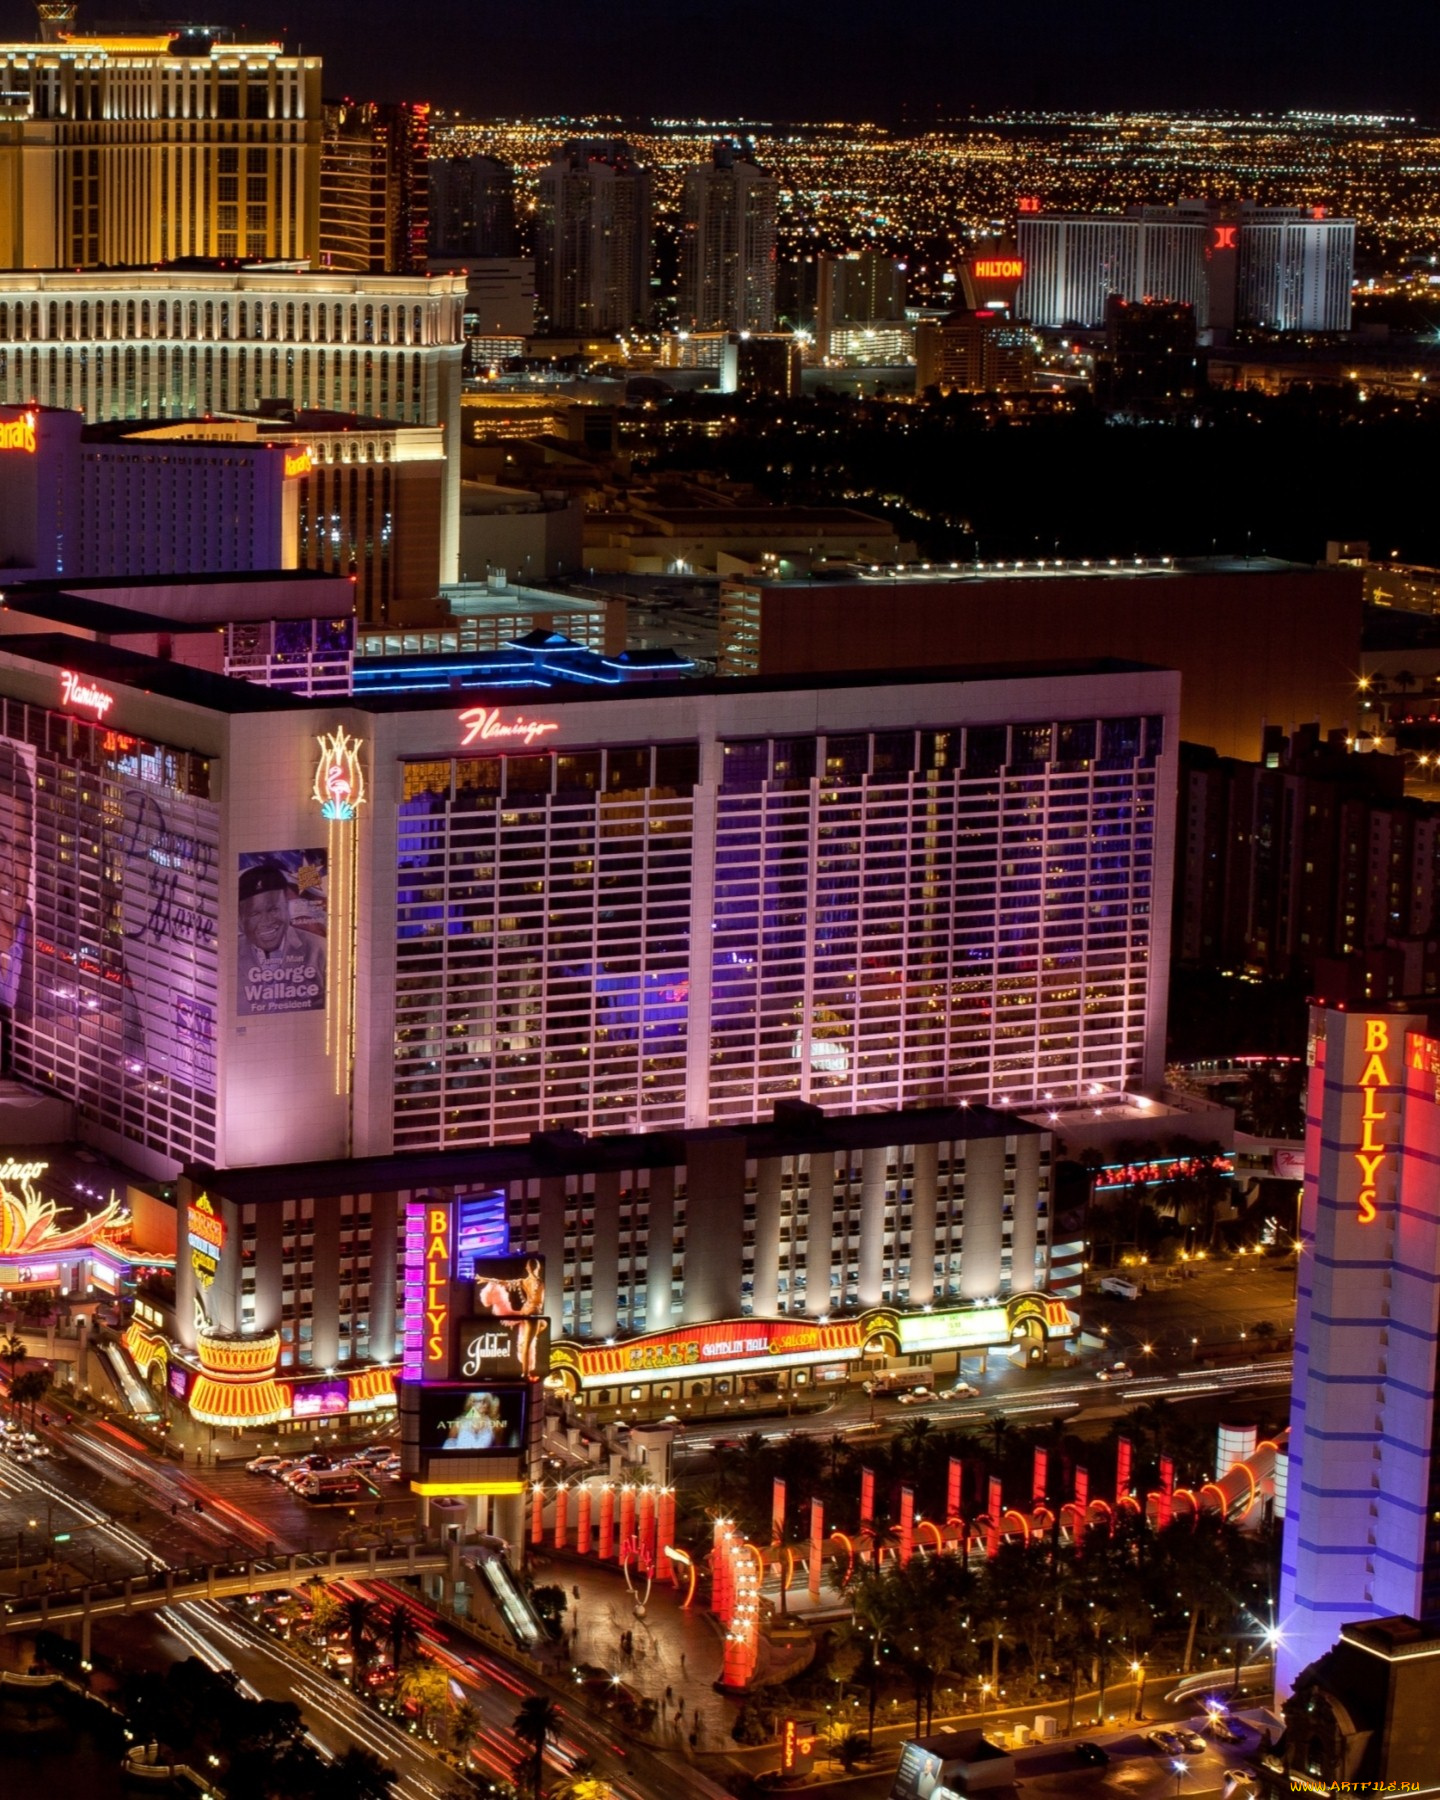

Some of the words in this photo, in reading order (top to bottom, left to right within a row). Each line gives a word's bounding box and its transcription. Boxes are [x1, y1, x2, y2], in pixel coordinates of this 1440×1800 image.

[975, 261, 1022, 277] HILTON
[60, 670, 113, 720] Flamingo
[459, 707, 558, 745] Flamingo
[286, 954, 304, 964] Man
[248, 966, 317, 984] George
[244, 983, 320, 1001] Wallace
[251, 1002, 265, 1012] For
[268, 1000, 312, 1011] President
[1355, 1019, 1391, 1224] BALLYS
[426, 1210, 448, 1360] BALLYS
[462, 1334, 511, 1377] Jubilee!
[745, 1337, 769, 1352] HALL
[780, 1332, 818, 1348] SALOON
[786, 1721, 795, 1768] BALLYS
